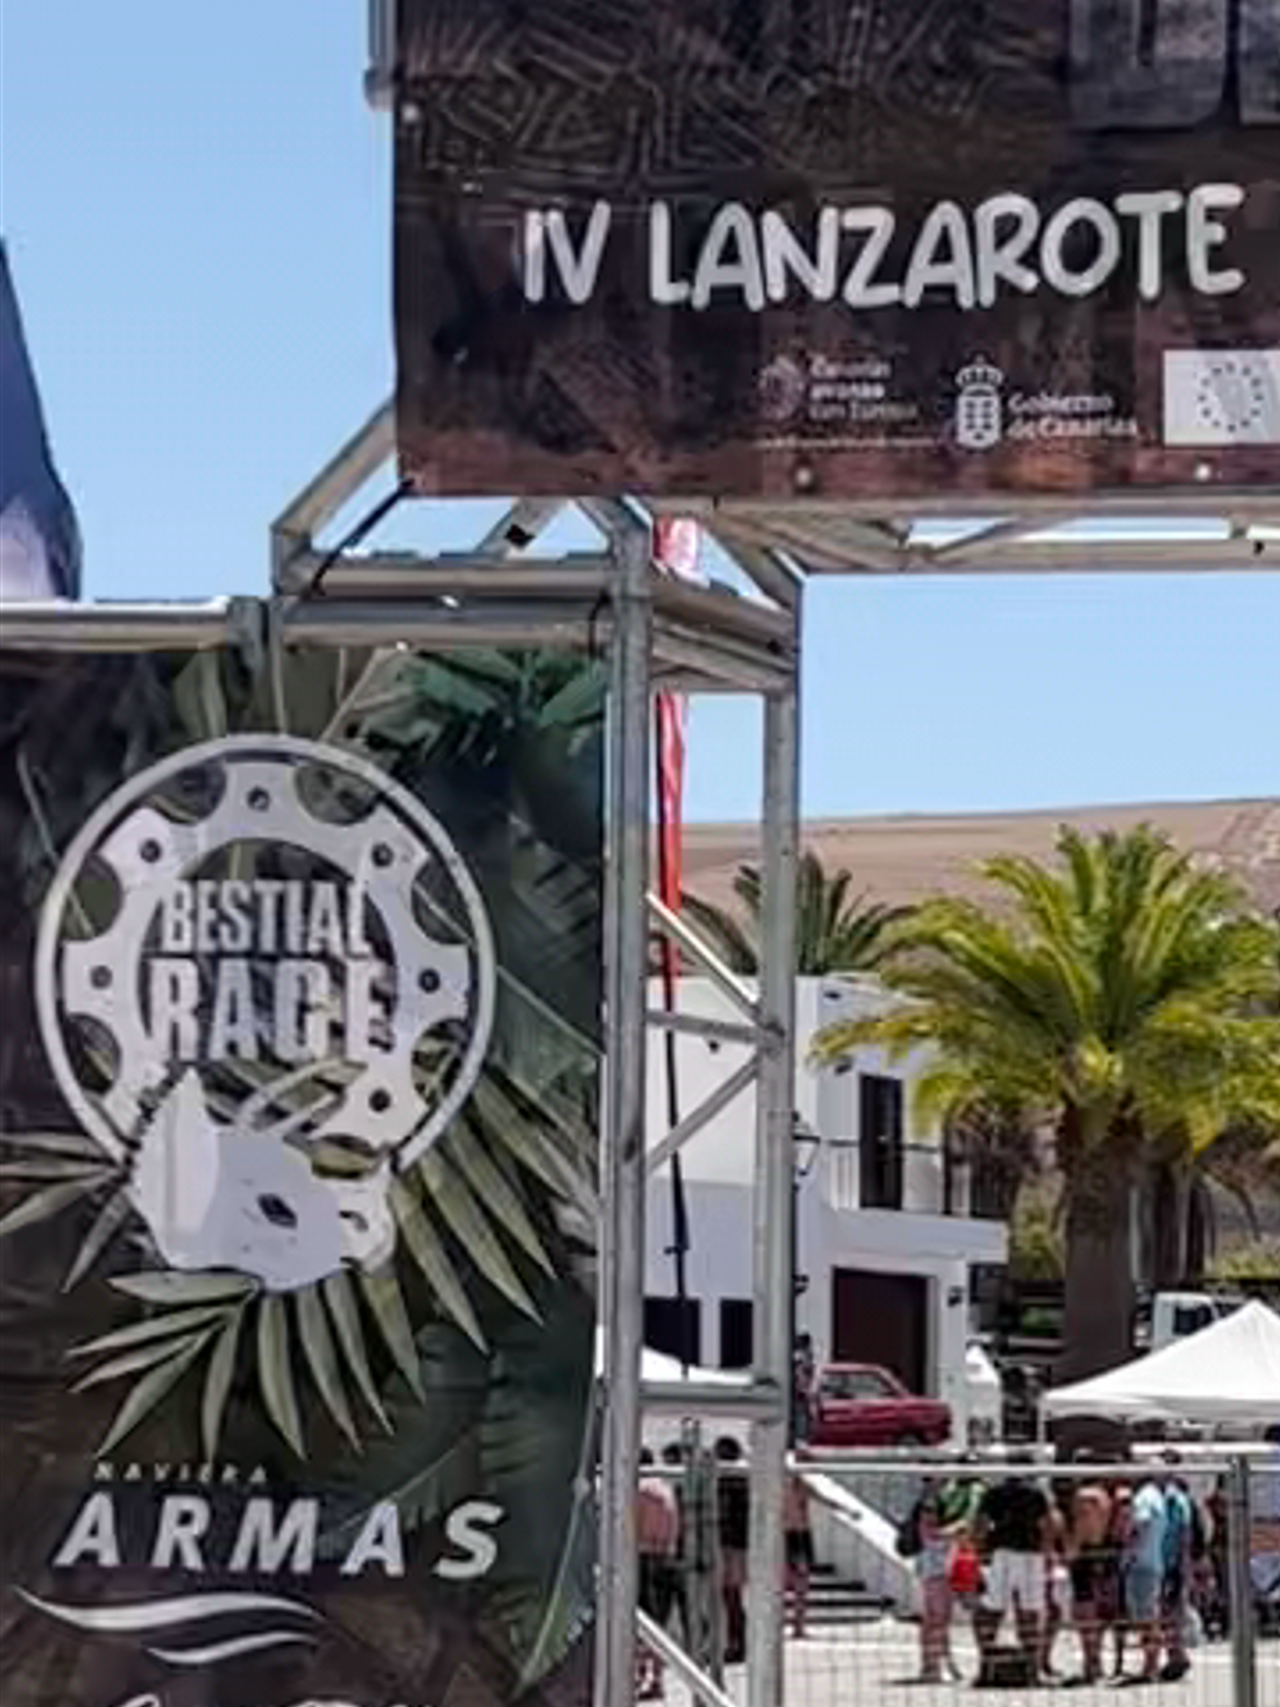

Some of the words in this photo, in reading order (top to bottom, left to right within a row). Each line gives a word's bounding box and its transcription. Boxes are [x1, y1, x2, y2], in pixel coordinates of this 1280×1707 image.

[524, 198, 612, 305] IV
[650, 183, 1244, 313] LANZAROTE
[161, 878, 373, 956] BESTIAL
[148, 956, 397, 1065] RACE
[53, 1492, 504, 1579] ARMAS
